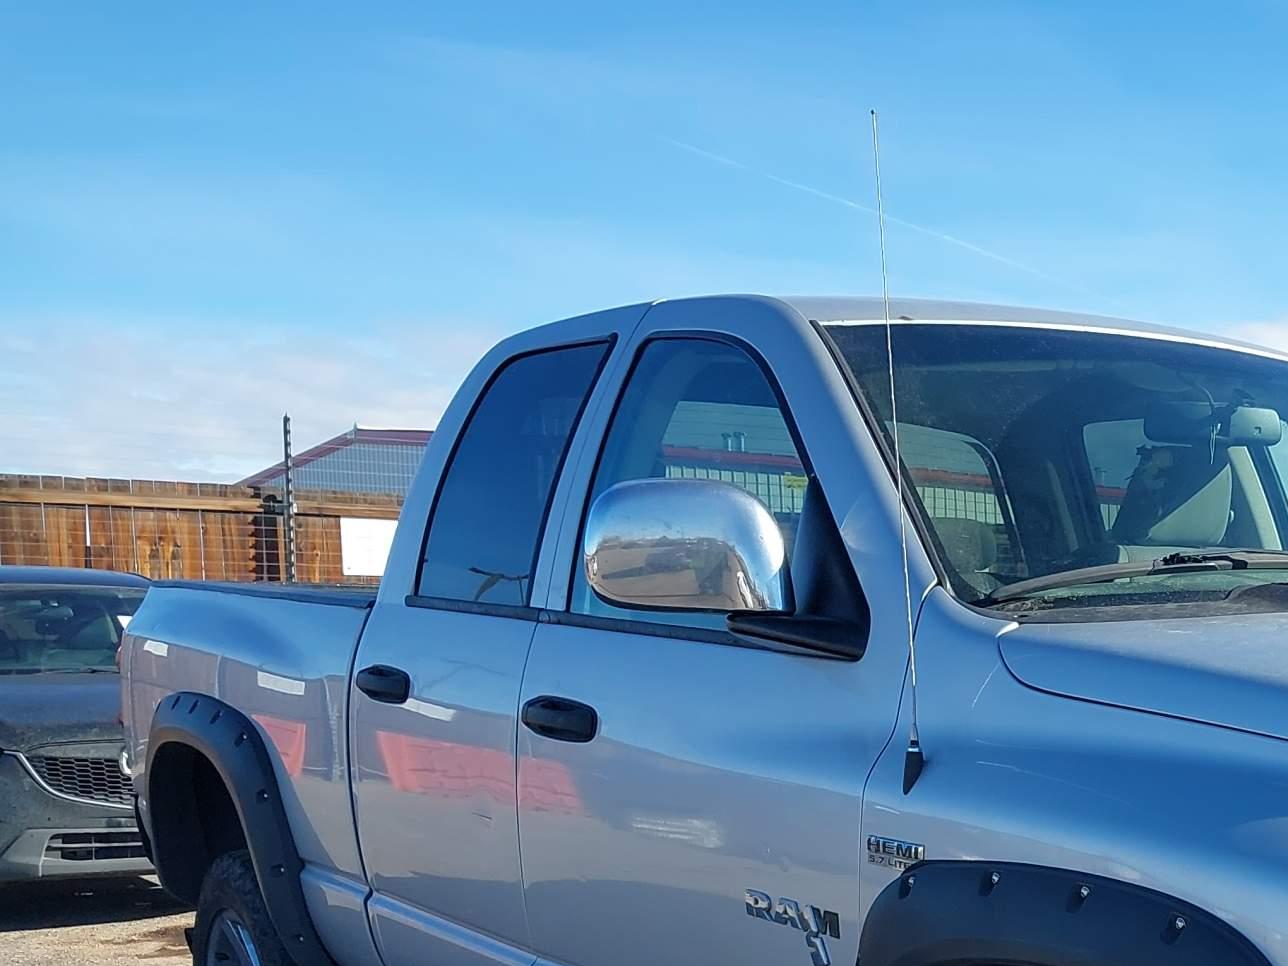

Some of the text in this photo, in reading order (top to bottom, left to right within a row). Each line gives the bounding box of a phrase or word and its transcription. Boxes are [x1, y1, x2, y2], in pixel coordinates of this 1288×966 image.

[866, 835, 926, 861] HEMI
[869, 854, 912, 870] 5.7 LITE
[744, 888, 841, 940] RAM
